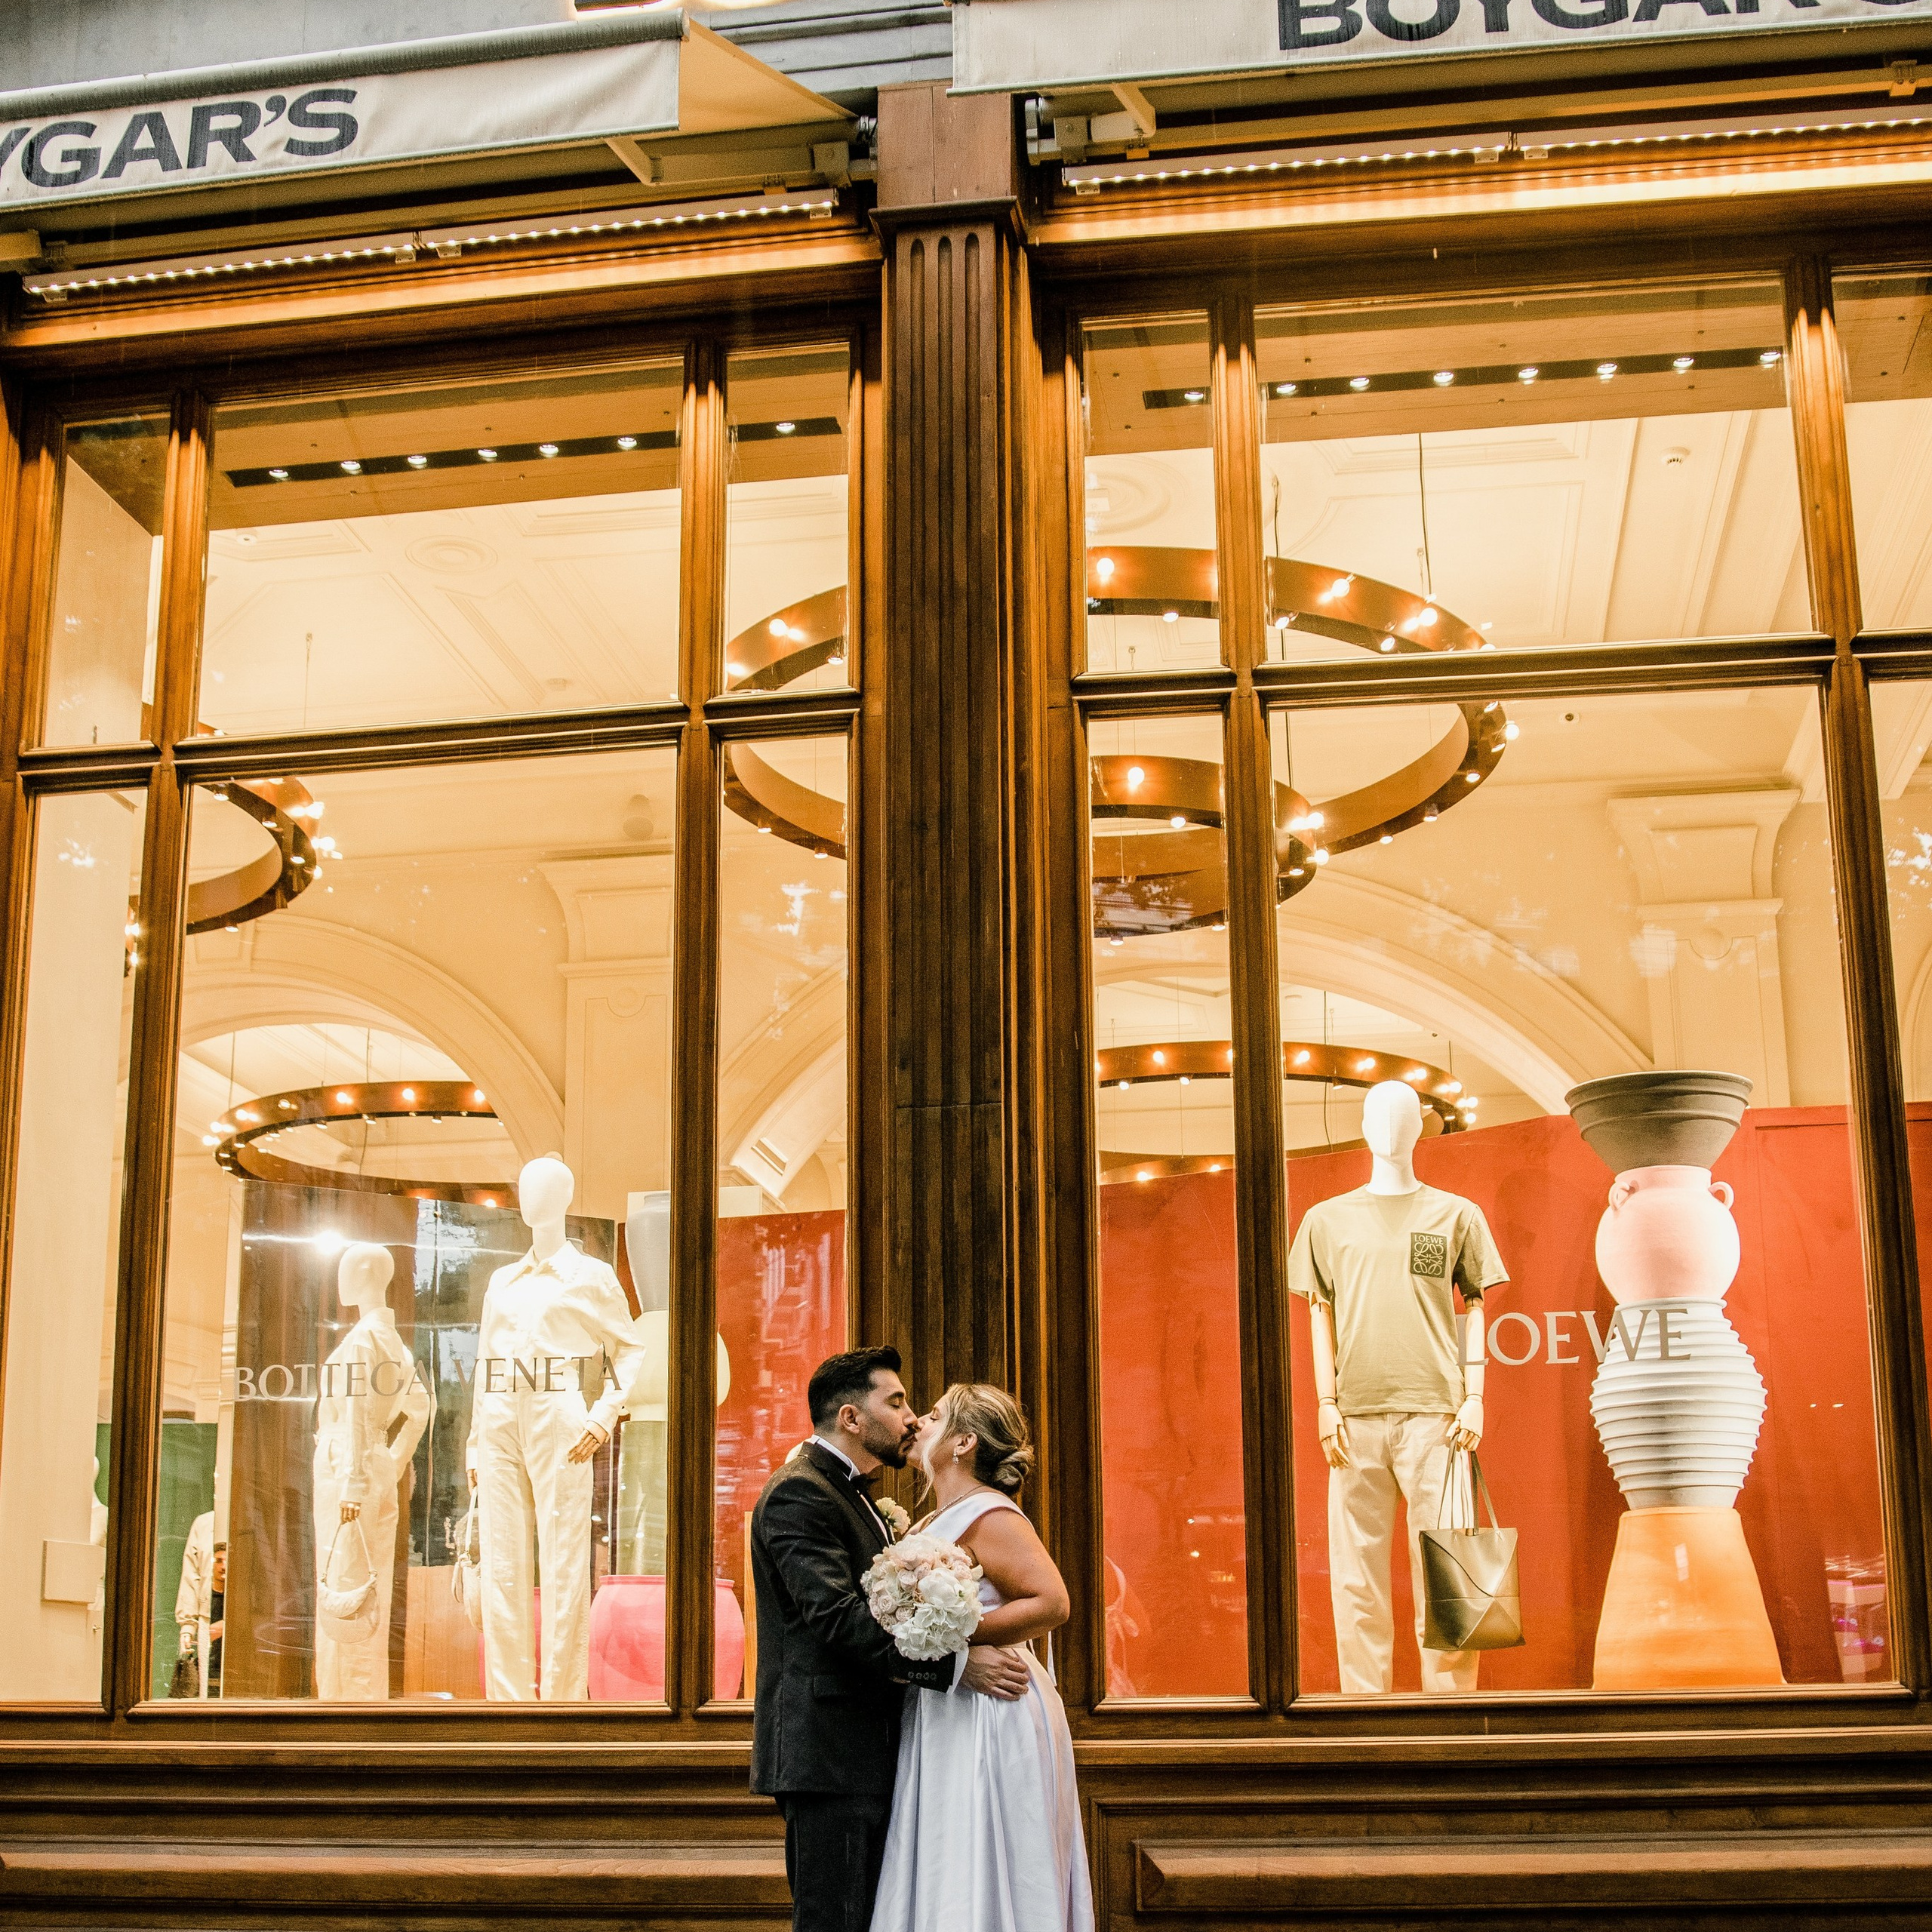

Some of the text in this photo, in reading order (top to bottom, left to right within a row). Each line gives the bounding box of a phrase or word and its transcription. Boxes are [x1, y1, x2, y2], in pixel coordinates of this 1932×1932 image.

[1414, 1234, 1444, 1245] LOEWE
[1455, 1308, 1691, 1366] LOEWE
[233, 1355, 623, 1402] BOTTEGA VENETA
